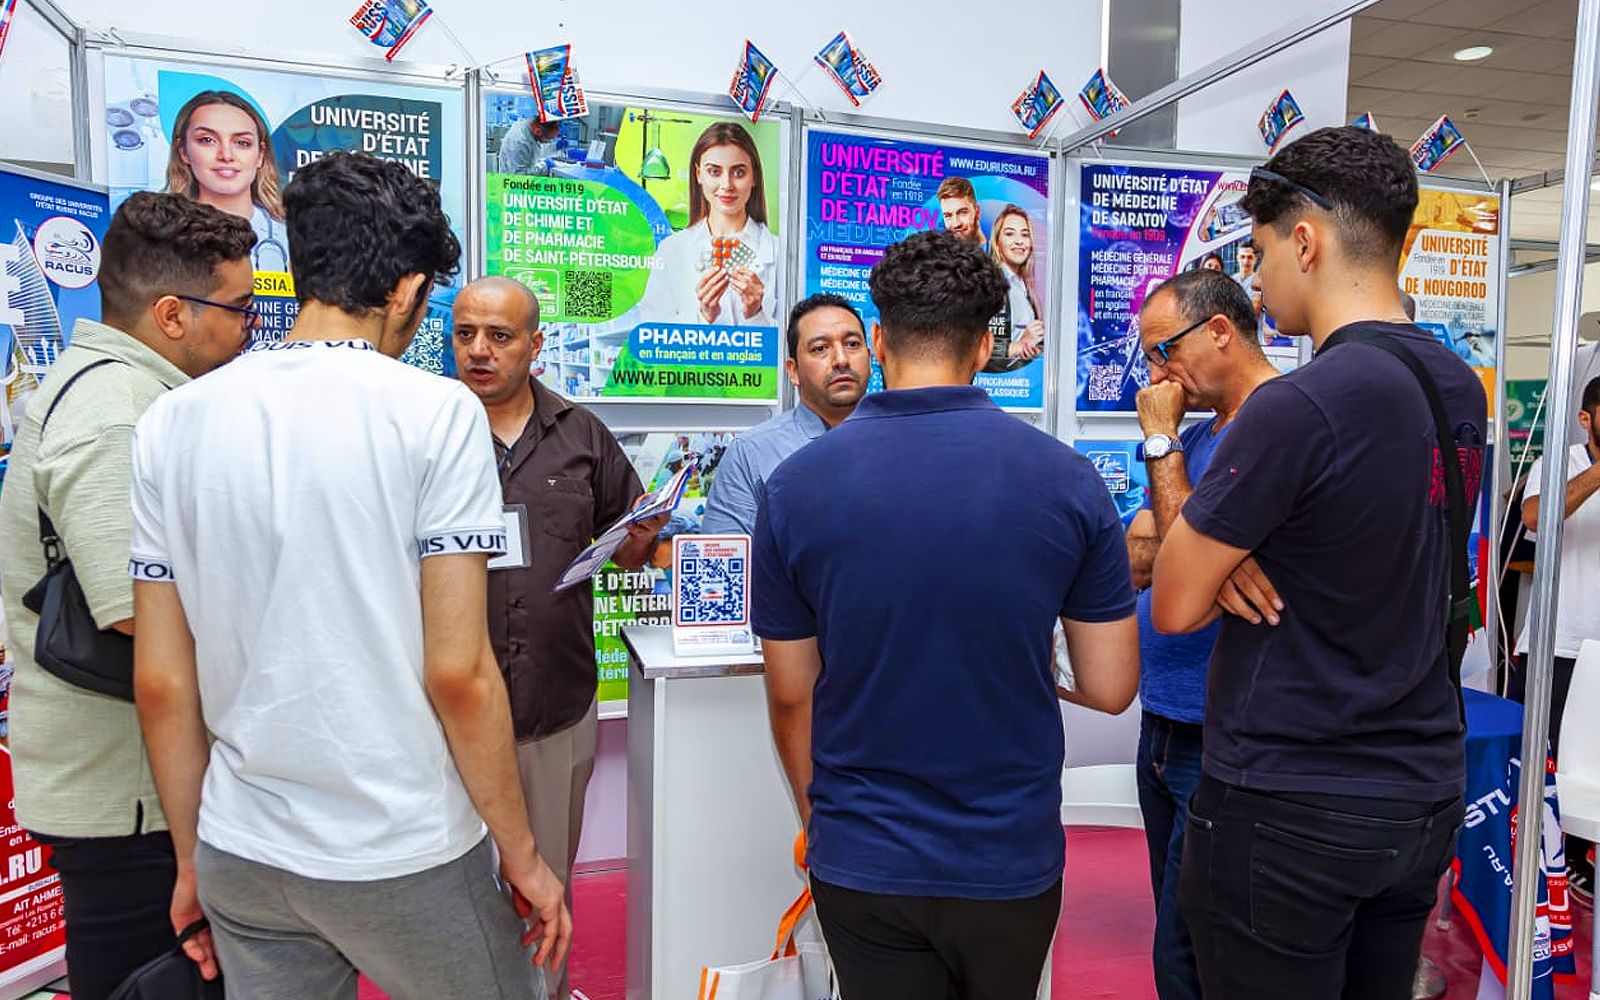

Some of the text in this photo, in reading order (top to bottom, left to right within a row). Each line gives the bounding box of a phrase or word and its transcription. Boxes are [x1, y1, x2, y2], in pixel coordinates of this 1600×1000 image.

[311, 104, 430, 135] UNIVERSITÉ
[363, 132, 430, 157] D'ÉTAT
[821, 142, 944, 179] UNIVERSITÉ
[949, 157, 1037, 178] WWW.EDURUSSIA.RU
[503, 178, 585, 195] Fondée en 1919
[820, 168, 891, 200] D'ÉTAT
[1093, 173, 1209, 194] UNIVERSITÉ D'ÉTAT
[503, 194, 629, 216] UNIVERSITÉ D'ÉTAT
[1092, 190, 1178, 212] DE MÉDECINE
[504, 212, 594, 231] DE CHIMIE ET
[821, 198, 941, 231] DE TAMBOV
[1092, 211, 1168, 228] DE SARATOV
[504, 230, 606, 249] DE PHARMACIE
[1421, 234, 1488, 257] UNIVERSITÉ
[504, 249, 665, 270] DE SAINT-PÉTERSBOURG
[1091, 250, 1173, 264] MÉDECINE GÉNÉRALE
[1450, 256, 1488, 278] D'ÉTAT
[45, 259, 93, 277] RACUS
[821, 265, 860, 279] MÉDECINE
[1091, 262, 1132, 274] MÉDECINE
[821, 277, 860, 290] MÉDECINE
[1091, 275, 1136, 287] PHARMACIE
[1405, 276, 1487, 299] DE NOVGOROD
[638, 326, 763, 348] PHARMACIE
[639, 347, 763, 364] en français et en anglais
[613, 368, 762, 389] WWW.EDURUSSIA.RU
[607, 569, 657, 591] D'ÉTAT
[32, 885, 63, 907] AHME
[25, 913, 48, 929] +213
